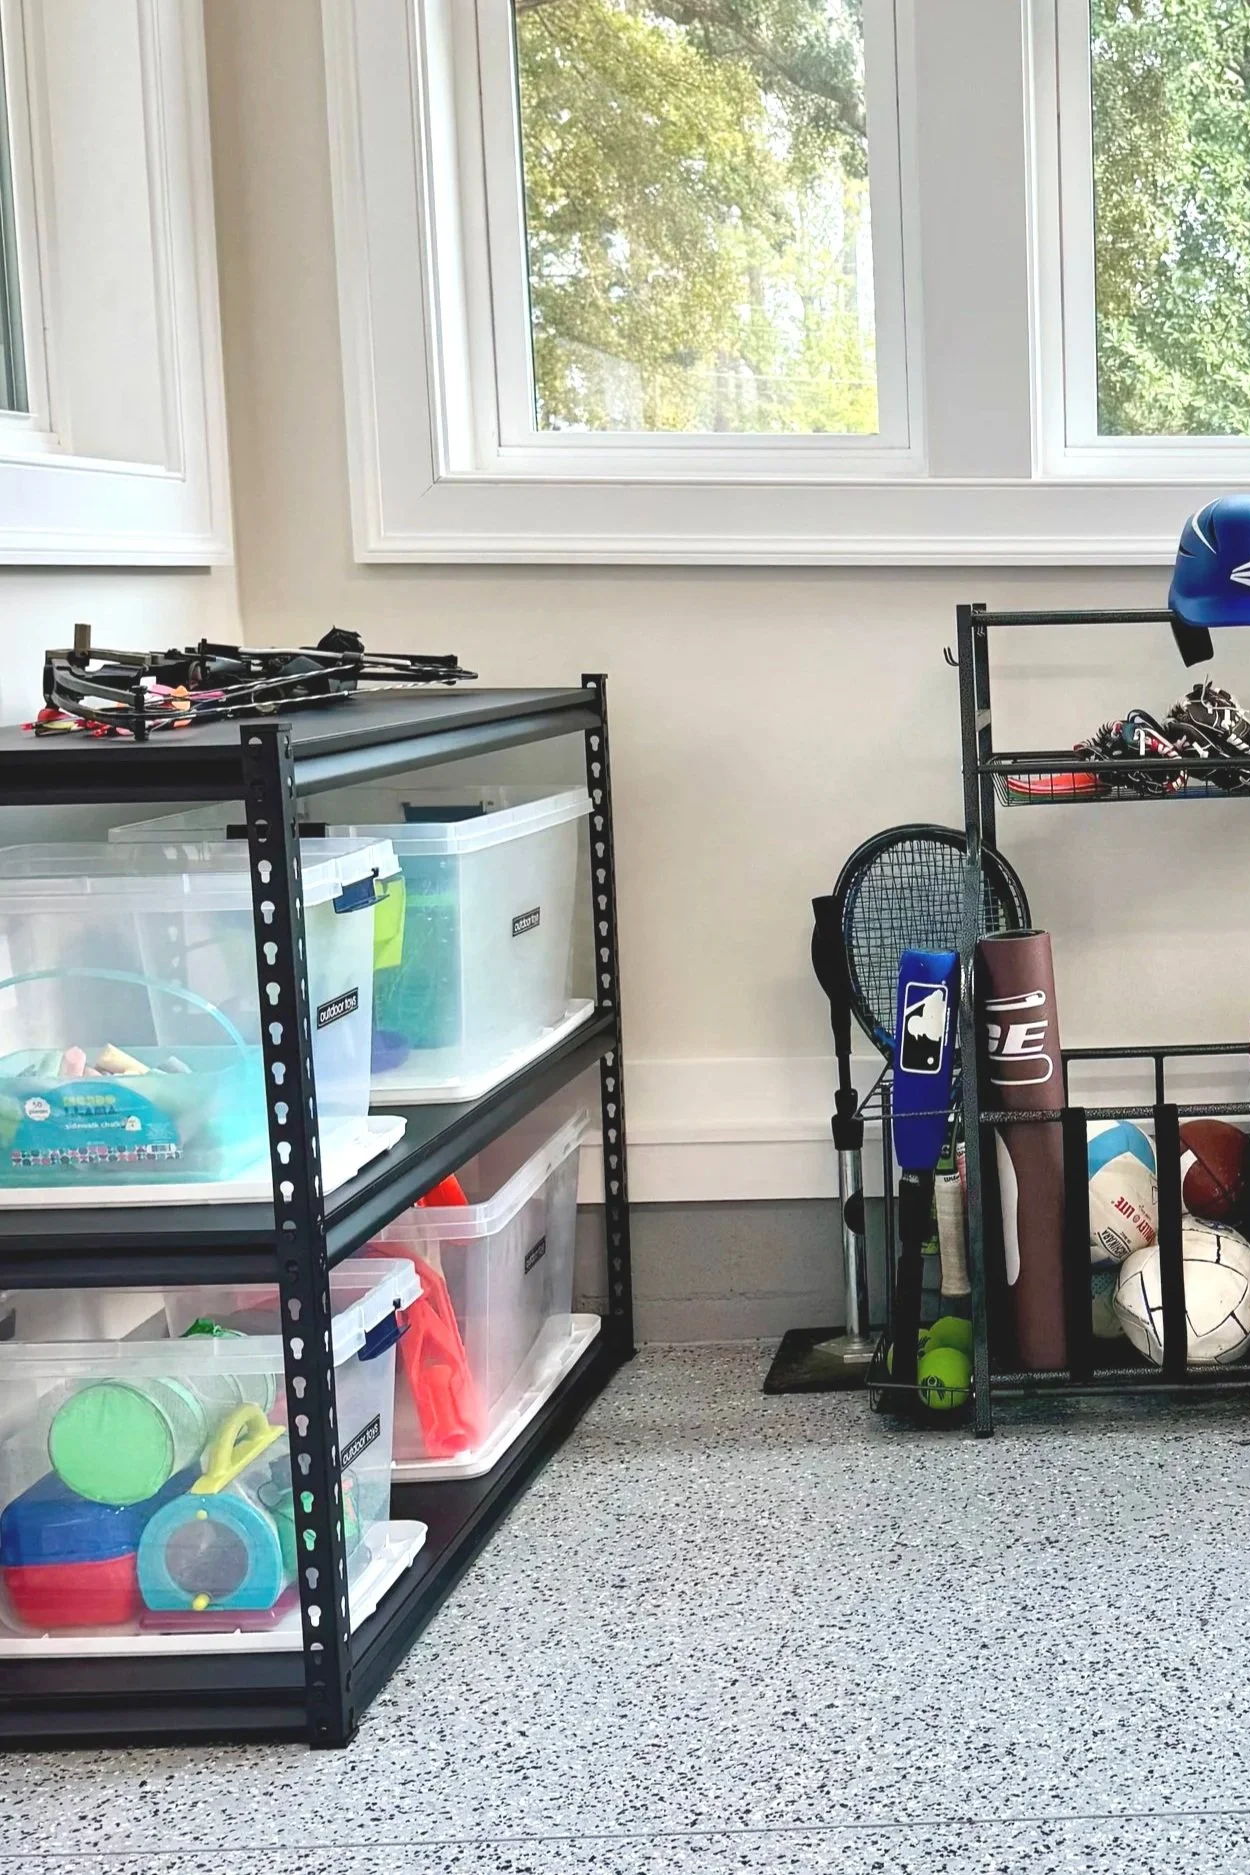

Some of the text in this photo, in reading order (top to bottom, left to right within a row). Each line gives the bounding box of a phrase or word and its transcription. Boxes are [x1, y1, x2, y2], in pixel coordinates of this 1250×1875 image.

[320, 995, 357, 1023] outdoor toys
[65, 1121, 99, 1130] sidewalk
[1114, 1196, 1136, 1219] LITE
[342, 1422, 378, 1465] outdoor toys
